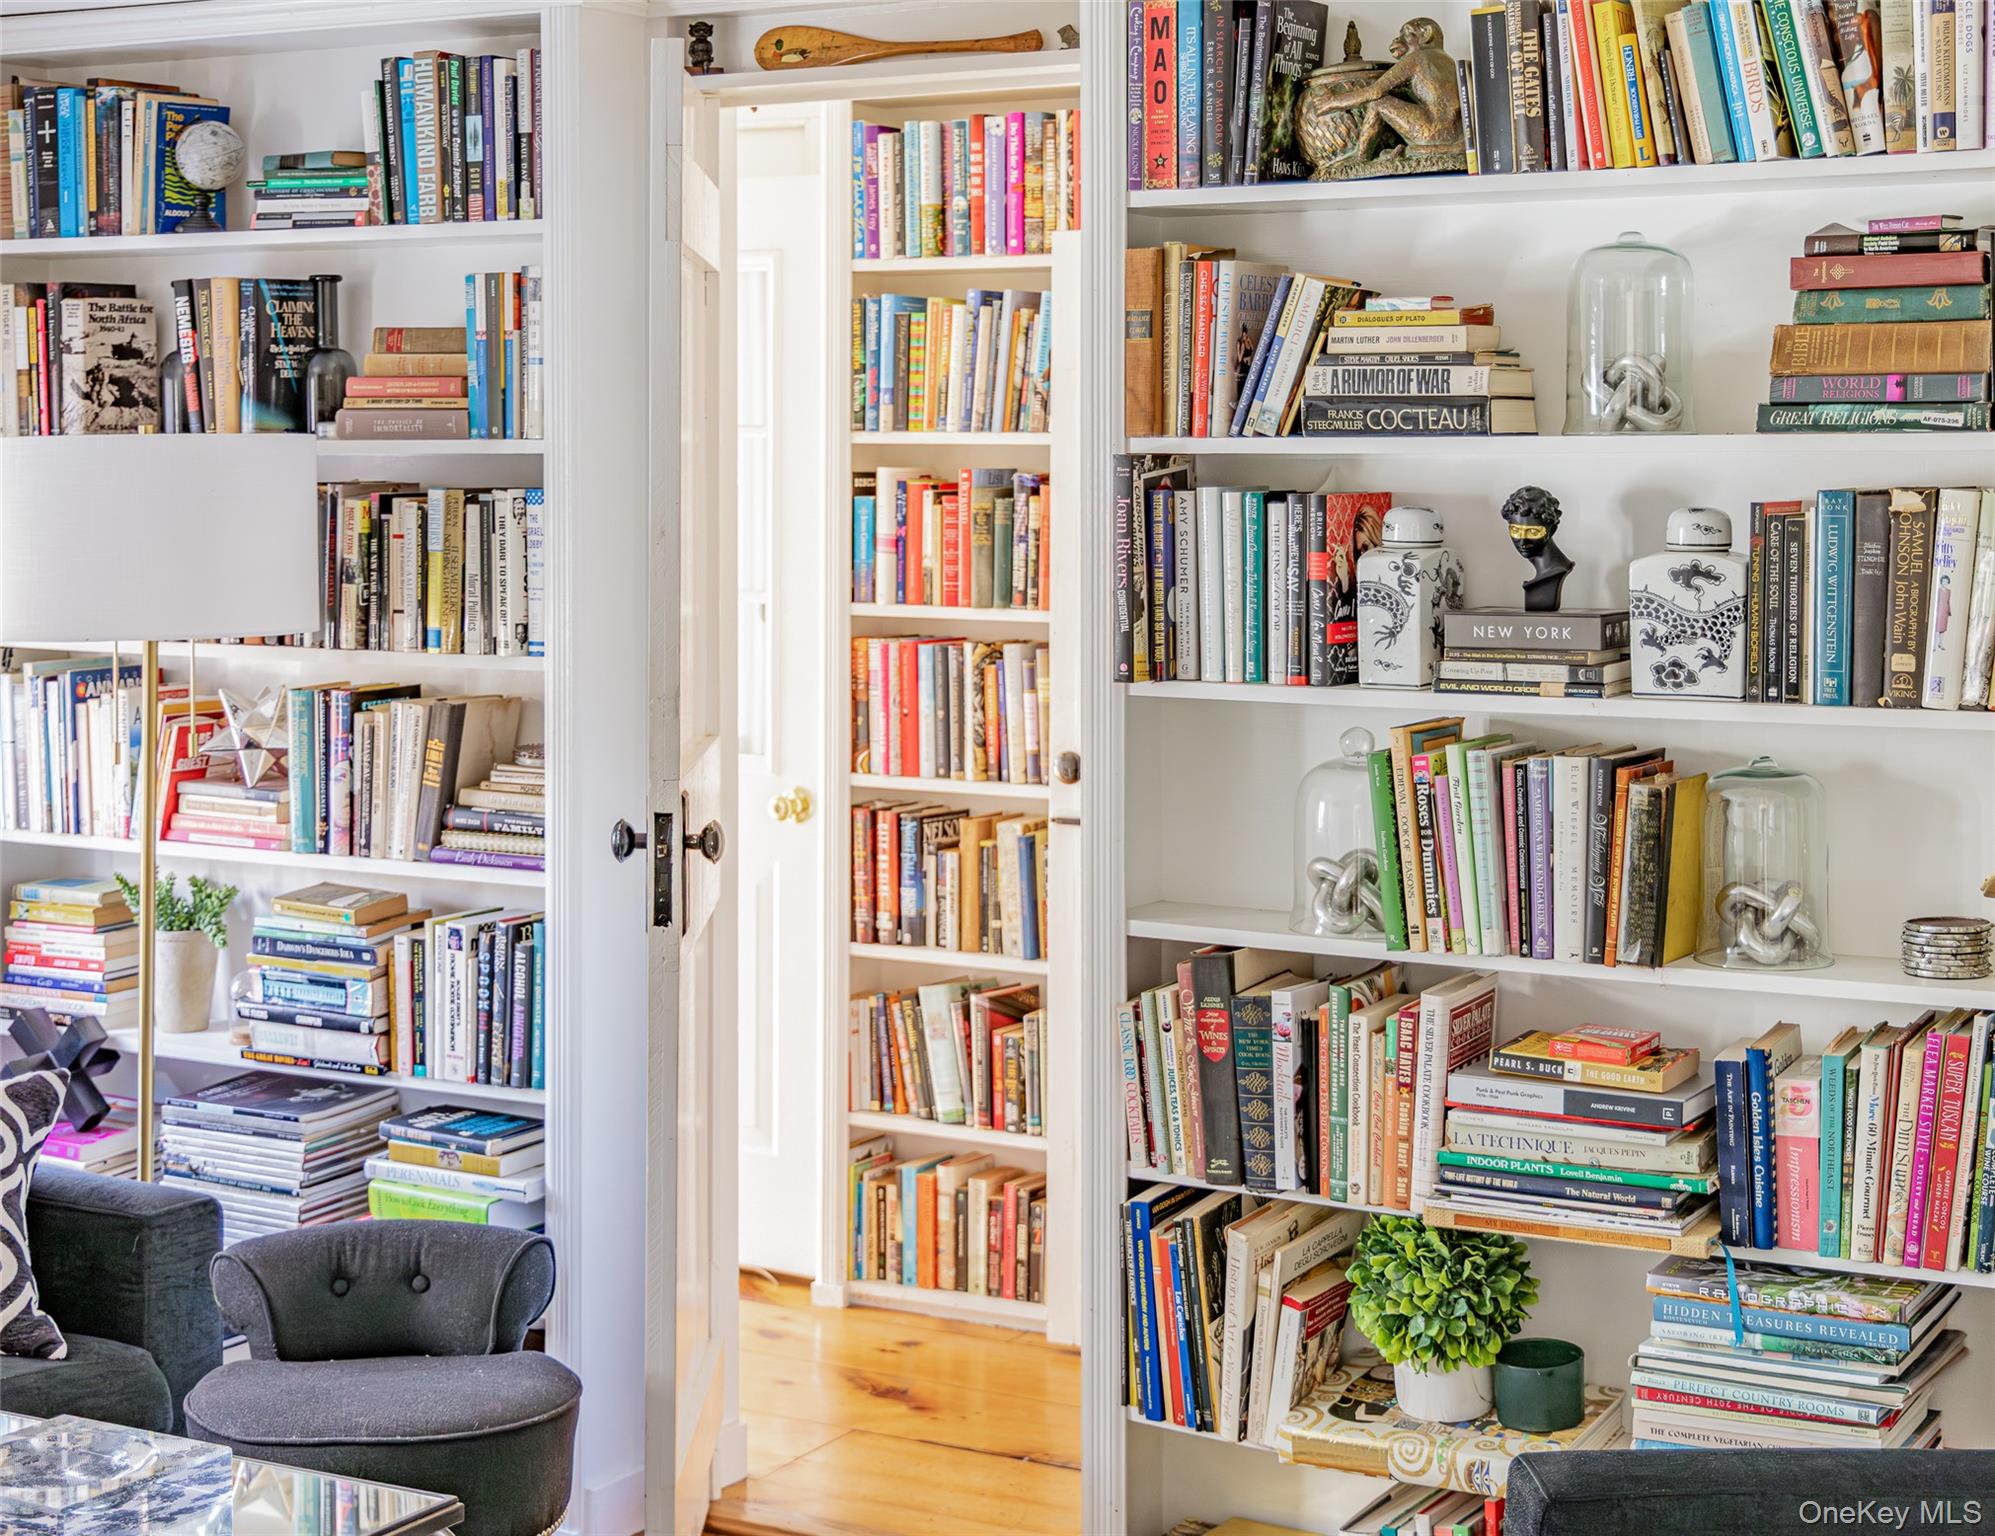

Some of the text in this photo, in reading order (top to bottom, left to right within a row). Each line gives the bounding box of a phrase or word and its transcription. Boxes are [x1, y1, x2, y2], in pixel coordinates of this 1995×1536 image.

[1216, 16, 1224, 27] IN
[1258, 16, 1267, 30] The
[1277, 16, 1318, 46] Beginning
[1965, 26, 1973, 54] DOGS
[1151, 16, 1170, 104] MAO
[1206, 41, 1214, 65] ERIC
[1254, 32, 1265, 70] Beginning
[1623, 46, 1636, 82] FRENCH
[1776, 12, 1814, 128] CONSCIOUS UNIVERSE
[1942, 20, 1951, 106] BRIAN KILCOMMONS
[1206, 69, 1214, 79] R.
[1216, 80, 1223, 95] OF
[1253, 83, 1261, 94] All
[1510, 51, 1527, 120] OF HELL
[1521, 29, 1541, 118] THE GATES
[1742, 60, 1764, 114] BIRDS
[1935, 68, 1943, 102] WILSON
[385, 86, 394, 133] REMEMBERED
[440, 104, 448, 148] NO BOUNDARY
[1215, 98, 1223, 146] MEMORY
[1251, 95, 1260, 121] Things
[413, 59, 438, 217] HUMANKIND FARB
[450, 60, 462, 198] Paul Davies Cosmic Jackpot
[388, 134, 396, 165] PRESENT
[520, 138, 528, 159] PAUL
[87, 302, 153, 314] The Battle for
[88, 314, 146, 324] North Africa
[1198, 270, 1207, 357] CHELSEA HANDLER
[1331, 336, 1380, 344] MARTIN LUTHER
[1792, 327, 1809, 366] BIBLE
[1822, 378, 1881, 389] WORLD
[1822, 390, 1880, 399] RELIGIONS
[1307, 421, 1364, 430] STEEGMULLER
[1328, 410, 1364, 419] FRANCIS
[1366, 408, 1467, 430] COCTEAU
[1770, 409, 1897, 425] GREAT RELIGIONS
[1116, 495, 1131, 633] Joan Rivers CONFIDENTIAL
[1179, 497, 1188, 594] AMY SCHUMER
[1910, 521, 1925, 576] SAMUEL
[499, 565, 506, 576] TO
[1286, 567, 1299, 593] SAY
[1770, 522, 1780, 610] CARE OF THE SOUL
[468, 573, 479, 631] Moral Politics
[1789, 576, 1797, 620] THEORIES
[1826, 524, 1838, 663] LUDWIG WITTGENSTEIN
[1893, 580, 1908, 644] John Wain
[1473, 626, 1573, 639] NEW YORK
[1789, 623, 1797, 636] OF
[1789, 638, 1797, 683] RELIGION
[494, 822, 544, 834] FAMILY
[1415, 783, 1438, 915] Roses Dummies
[1534, 794, 1546, 930] AMERICAN WEEKEND GARDEN
[478, 952, 490, 1010] SPOOK
[513, 951, 526, 1000] ALCOHOL
[1352, 1022, 1361, 1036] The
[1352, 1038, 1361, 1057] Yeast
[1119, 1012, 1141, 1144] CLASSIC COCKTAILS
[1275, 1045, 1291, 1103] Mocktails
[1352, 1058, 1361, 1095] Connection
[1420, 1008, 1435, 1130] THE SILVER PALATE COOKBOOK
[1494, 1057, 1563, 1074] PEARL S. BUCK
[1351, 1096, 1361, 1126] Cookbook
[1916, 1037, 1940, 1153] FLEA MARKET STYLE
[1940, 1060, 1965, 1142] SUPER TUSCAN
[1454, 1131, 1574, 1155] LA TECHNIQUE
[1751, 1092, 1764, 1208] Golden Isles Cuisine
[1863, 1095, 1879, 1219] More 60 Minute Gourmet
[386, 1167, 460, 1187] PERENNIALS
[1467, 1156, 1623, 1183] INDOOR PLANTS Lovell Benjamin
[1981, 1150, 1991, 1205] WINE COURSE
[1565, 1186, 1636, 1203] The Natural World
[1787, 1145, 1803, 1241] Impressionism
[1175, 1291, 1185, 1341] Los Caprichos
[1663, 1303, 1899, 1345] HIDDEN TEASURES REVEALED
[1673, 1380, 1845, 1417] PERFECT COUNTRY ROOMS
